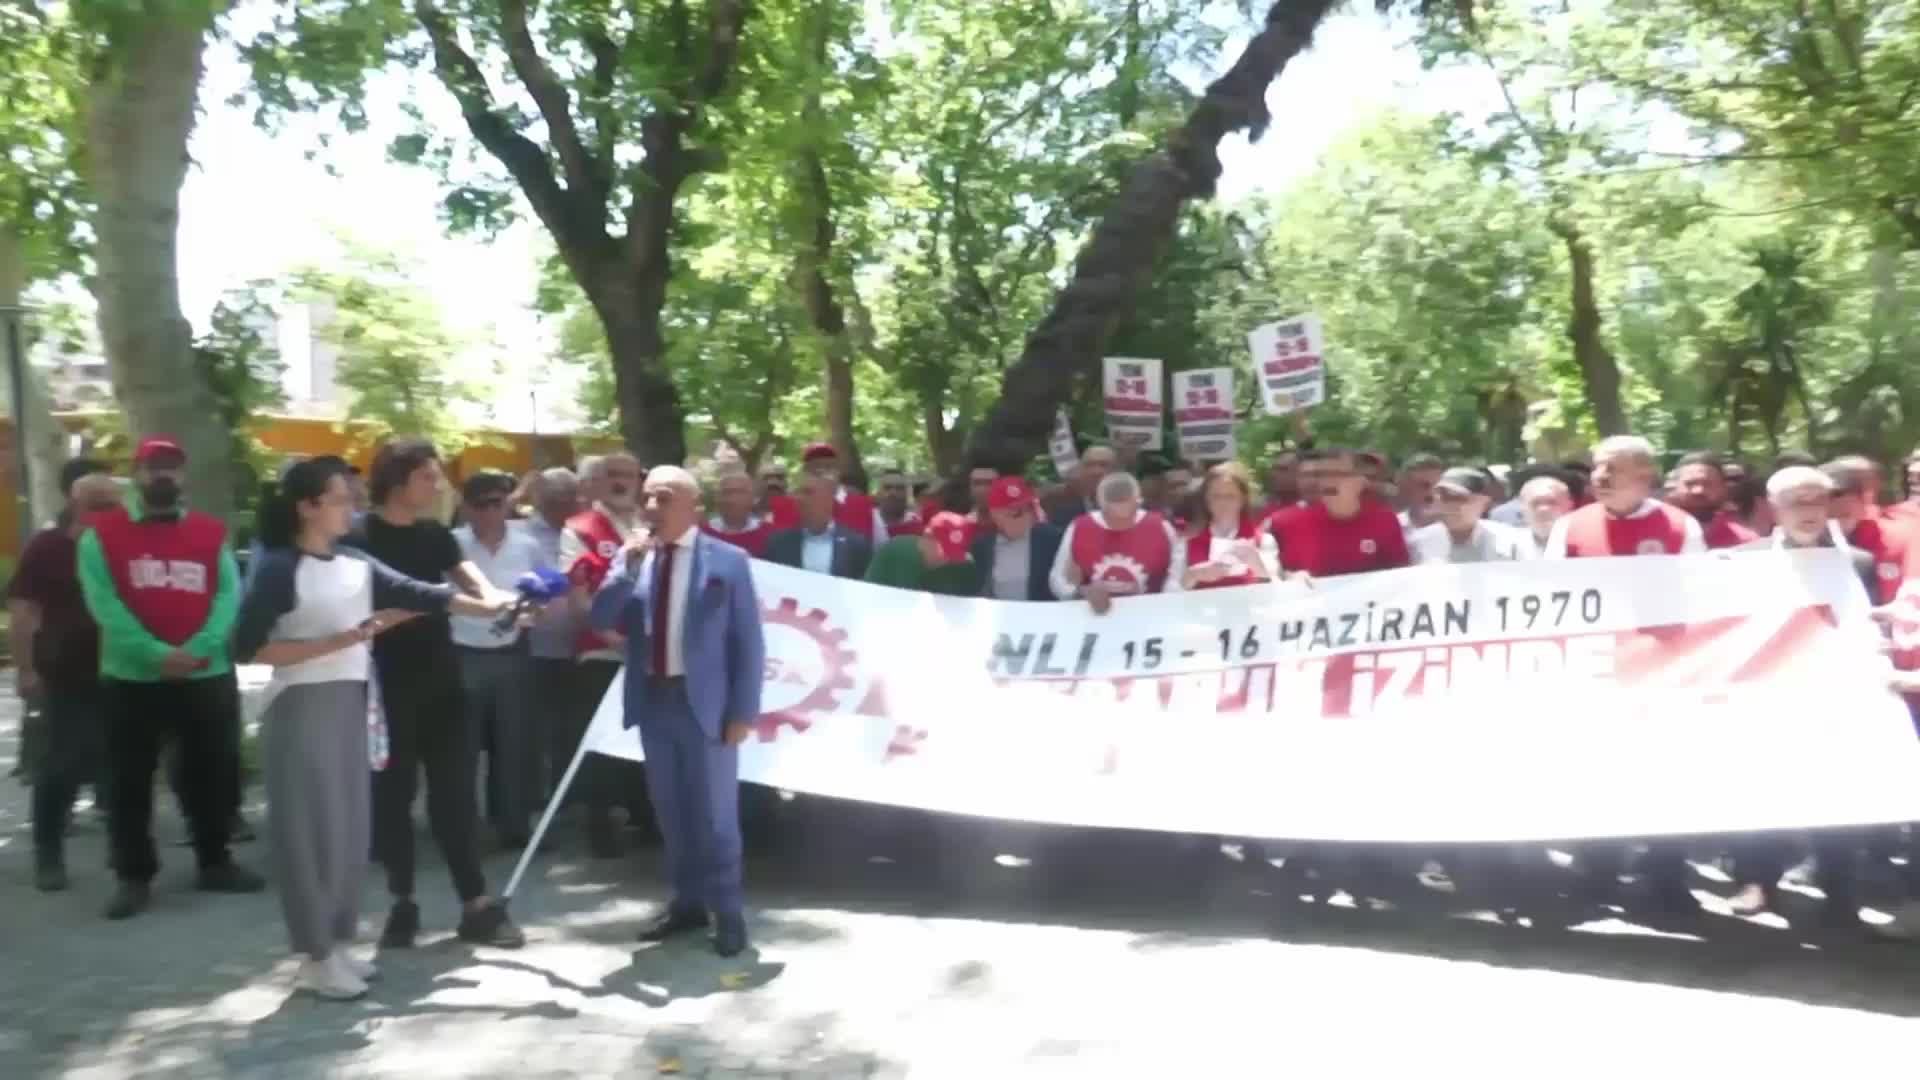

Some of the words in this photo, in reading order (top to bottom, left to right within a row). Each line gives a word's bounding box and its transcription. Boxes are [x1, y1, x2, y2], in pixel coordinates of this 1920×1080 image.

[1122, 637, 1163, 669] 15
[1217, 626, 1260, 661] 16
[1495, 588, 1602, 633] 1970
